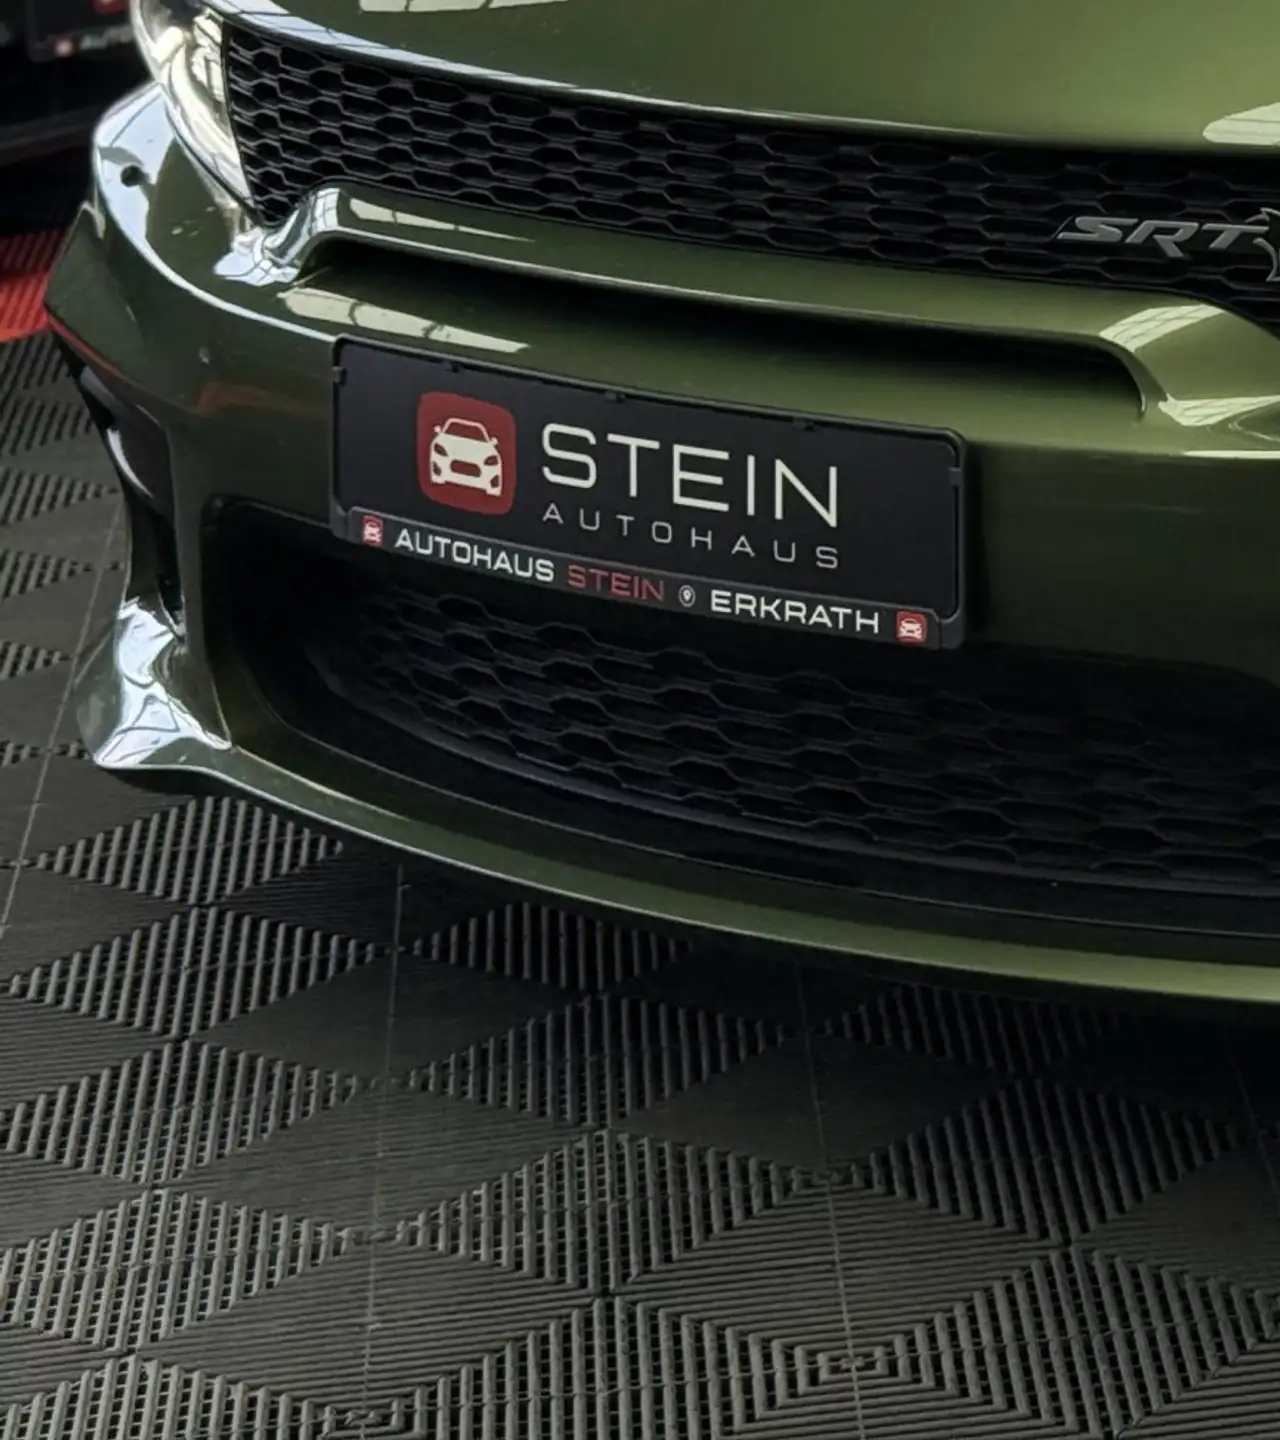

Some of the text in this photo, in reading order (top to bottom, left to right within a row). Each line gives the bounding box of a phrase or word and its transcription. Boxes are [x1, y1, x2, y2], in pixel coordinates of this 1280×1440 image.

[1056, 215, 1269, 257] SRT
[542, 422, 838, 528] STEIN
[542, 502, 838, 569] AUTOHAUS
[393, 527, 879, 635] AUTOHAUS STEIN ERKRATH
